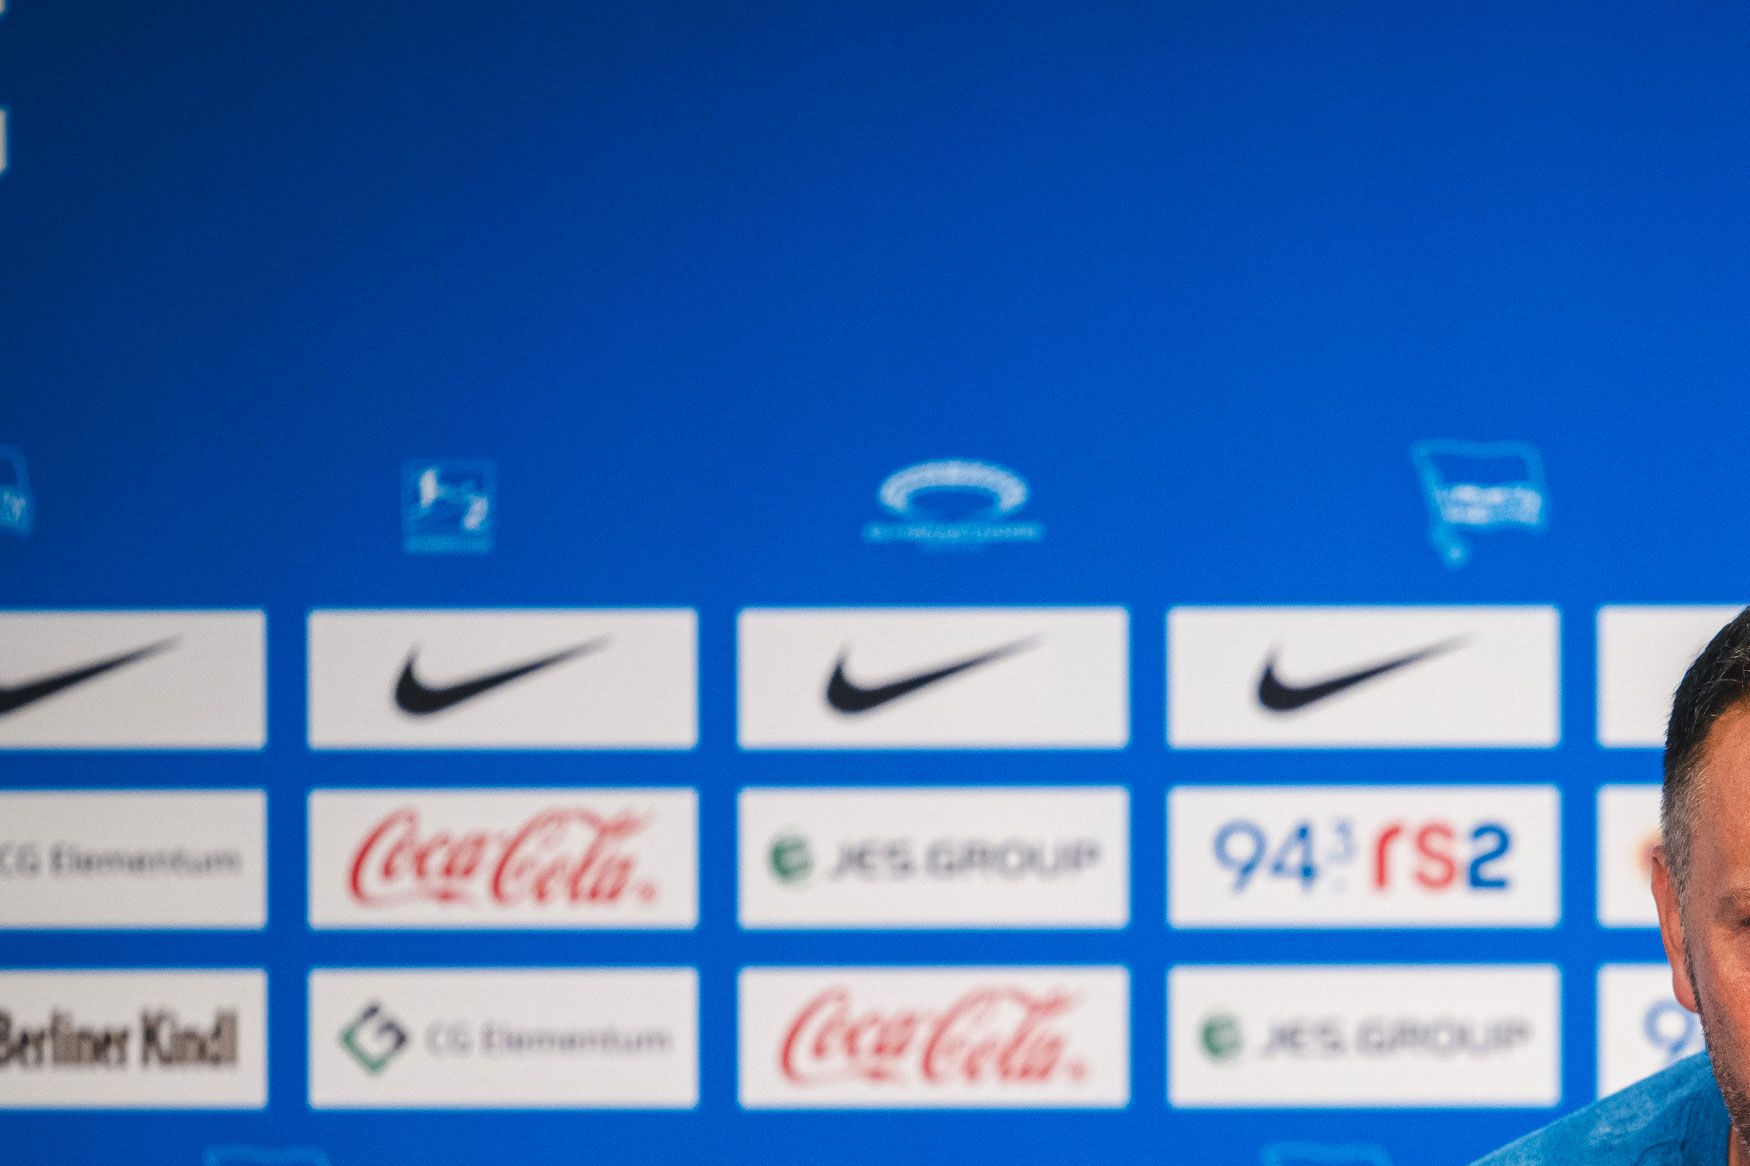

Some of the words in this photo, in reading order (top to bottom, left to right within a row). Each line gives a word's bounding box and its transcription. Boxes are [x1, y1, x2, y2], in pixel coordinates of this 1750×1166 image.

[50, 841, 241, 878] Elementum
[141, 1004, 239, 1070] Kindl
[479, 1020, 672, 1058] Elementum
